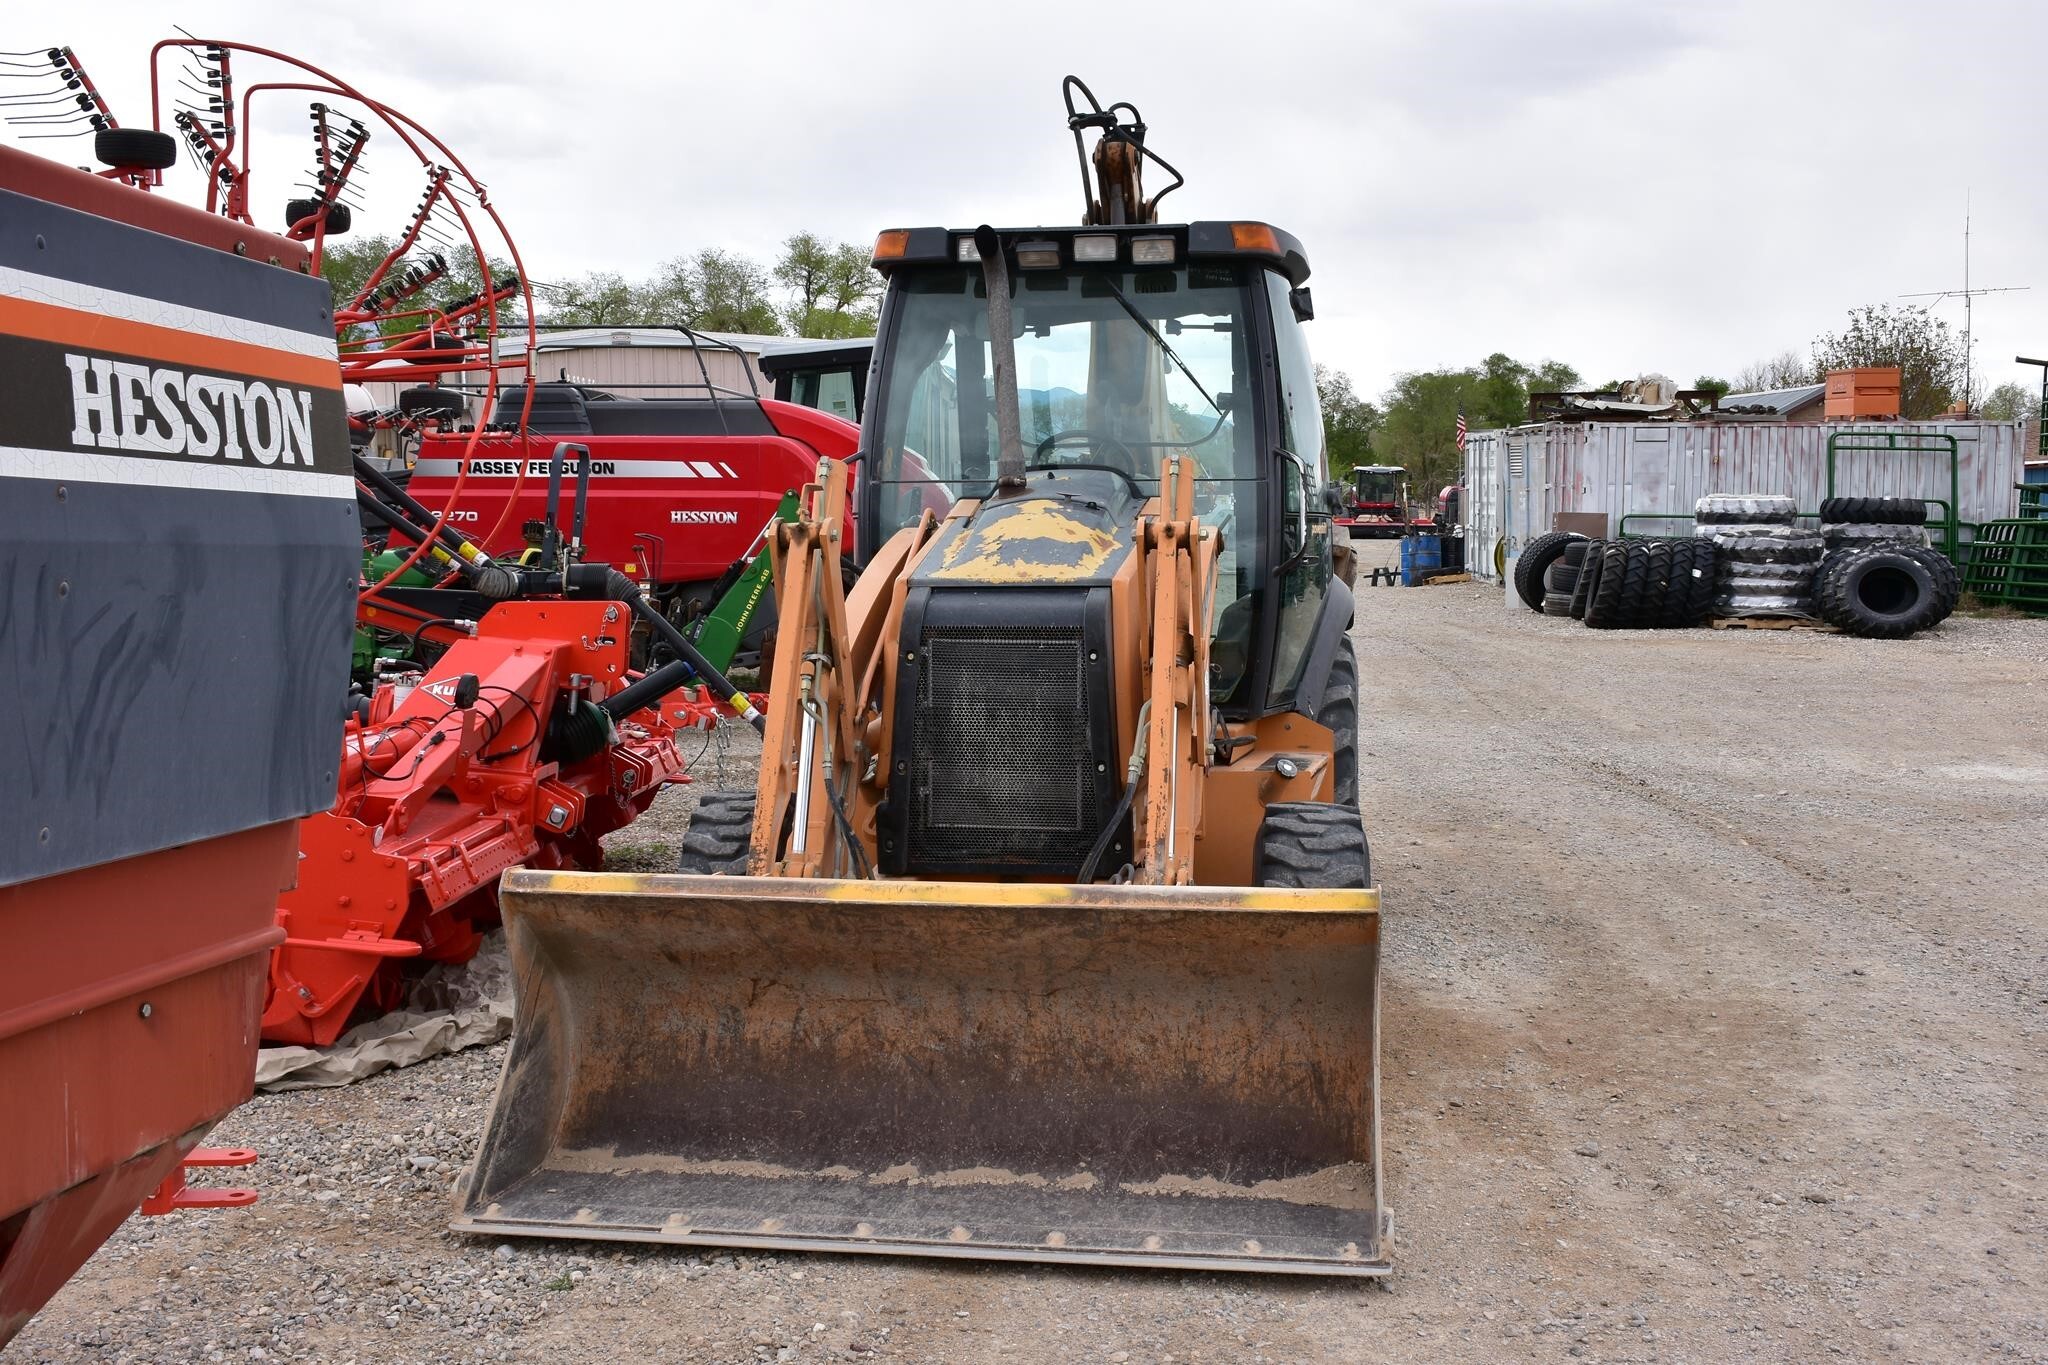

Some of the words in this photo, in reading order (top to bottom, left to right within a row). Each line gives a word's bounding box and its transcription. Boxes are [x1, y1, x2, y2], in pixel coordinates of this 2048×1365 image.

[65, 353, 314, 466] HESSTON
[529, 461, 615, 475] FEGUON
[670, 510, 738, 524] HESSTON
[736, 610, 749, 633] JOHN
[746, 583, 763, 611] DEERE
[432, 684, 457, 697] KU
